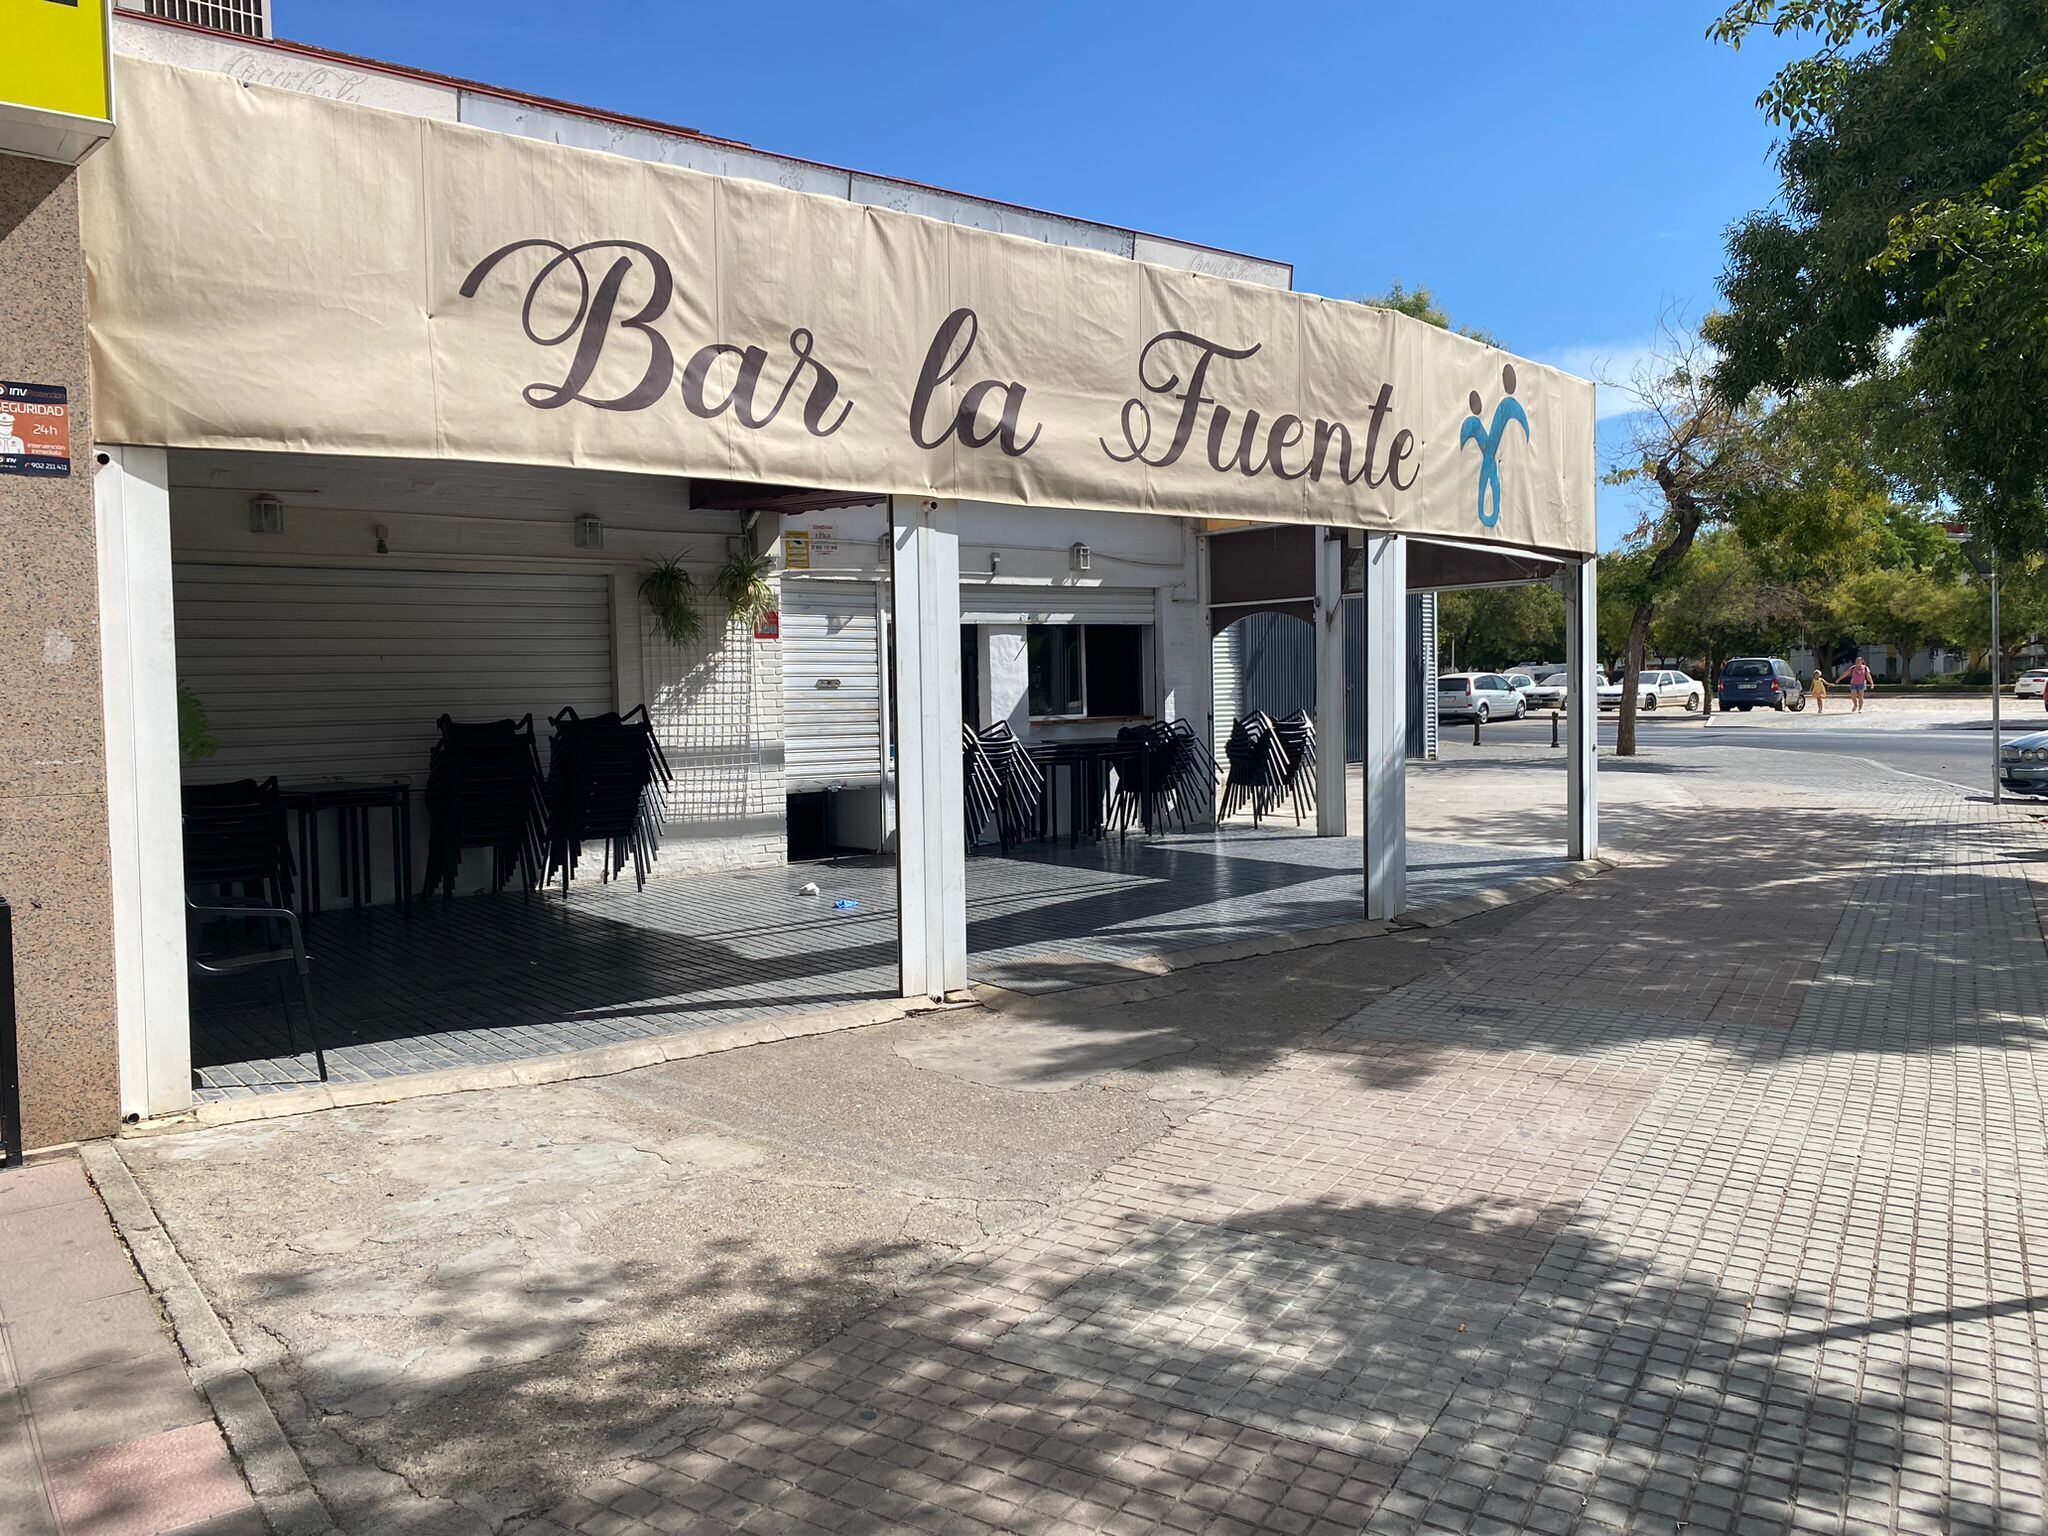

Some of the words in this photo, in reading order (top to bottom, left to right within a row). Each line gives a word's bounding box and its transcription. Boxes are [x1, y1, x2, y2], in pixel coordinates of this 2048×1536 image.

[459, 238, 855, 437] Bar
[910, 307, 1043, 456] la
[1099, 330, 1421, 491] Fuente
[0, 402, 64, 417] EGURIDAD
[32, 423, 58, 436] 24h
